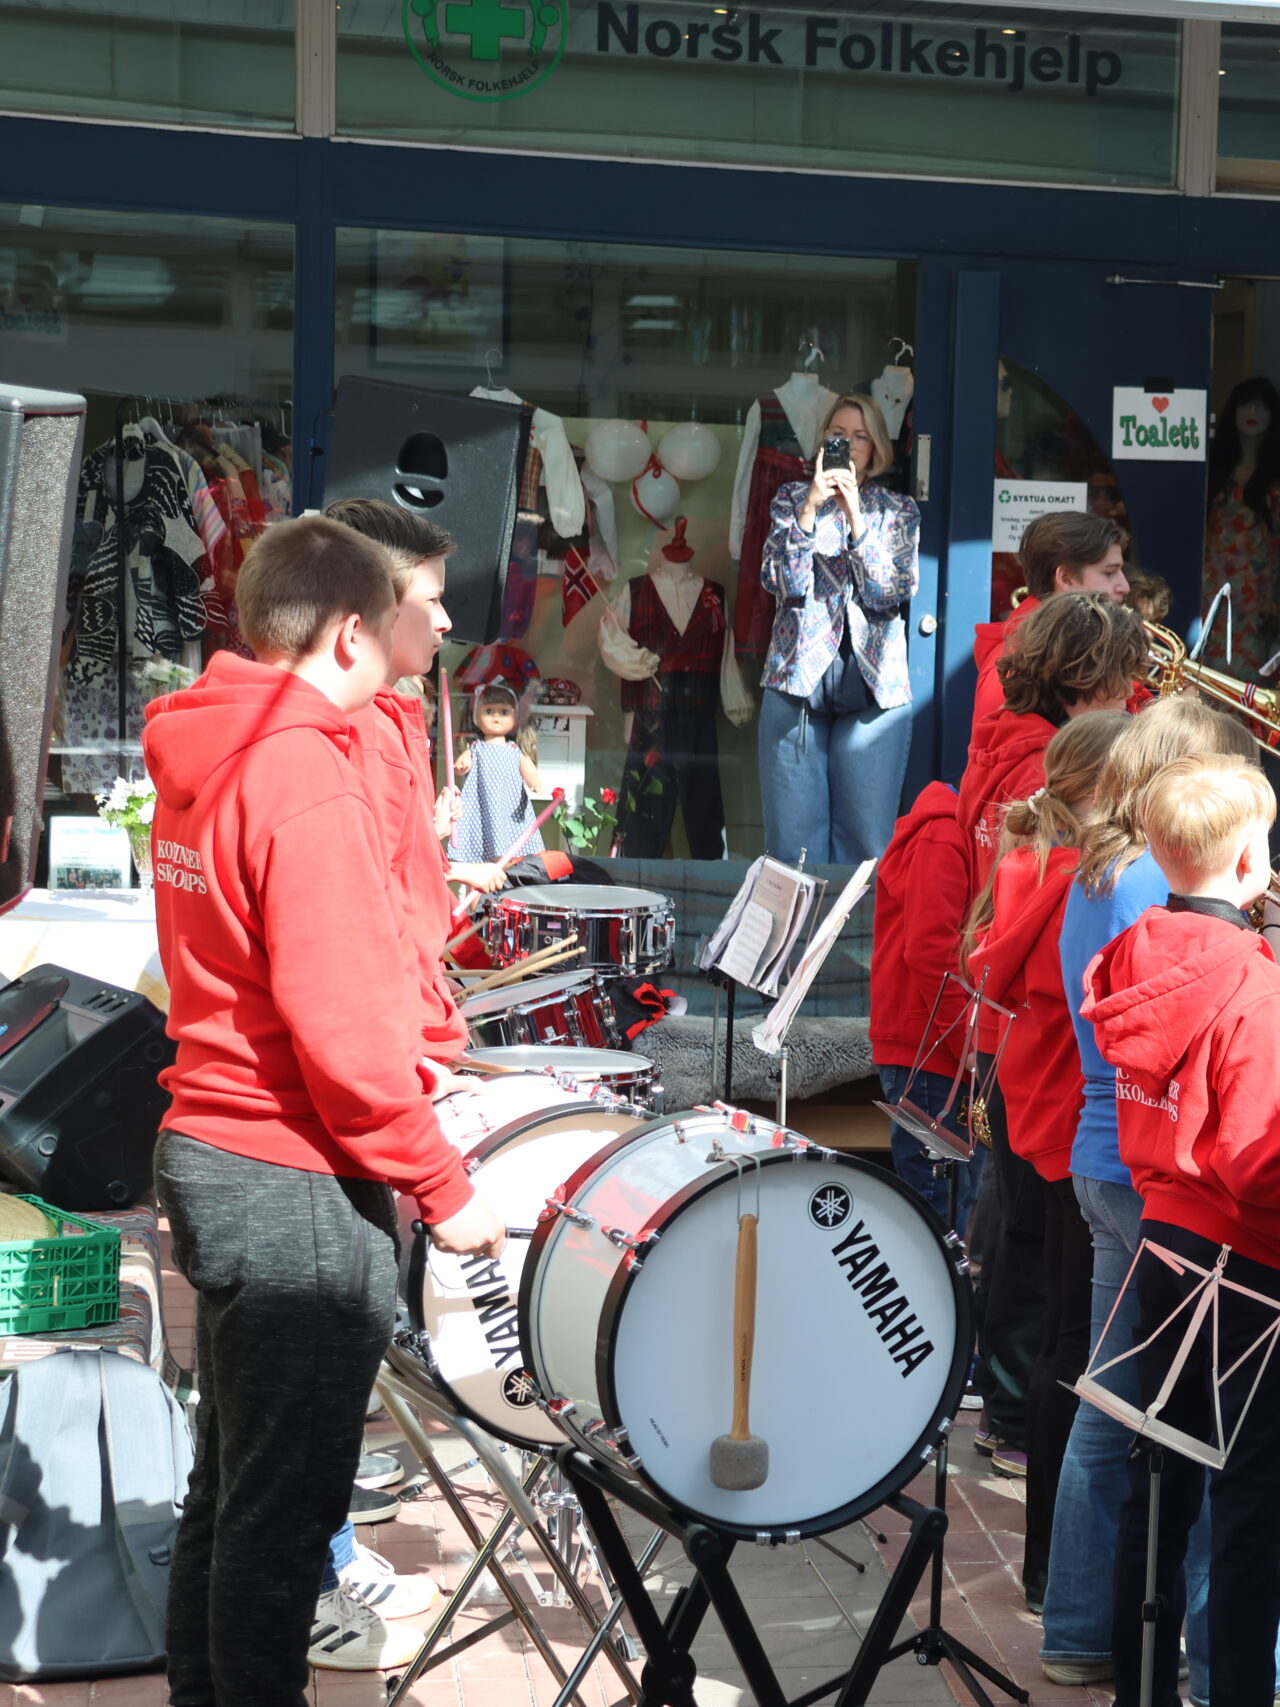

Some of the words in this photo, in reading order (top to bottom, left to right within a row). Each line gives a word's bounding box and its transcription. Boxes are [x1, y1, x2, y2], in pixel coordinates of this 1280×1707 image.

[428, 51, 466, 87] NORSK
[467, 59, 541, 92] FOLKEHJELP
[597, 3, 784, 64] Norsk
[805, 16, 1122, 96] Folkehjelp
[1119, 415, 1200, 450] Toalett
[831, 1219, 935, 1379] YAMAHA
